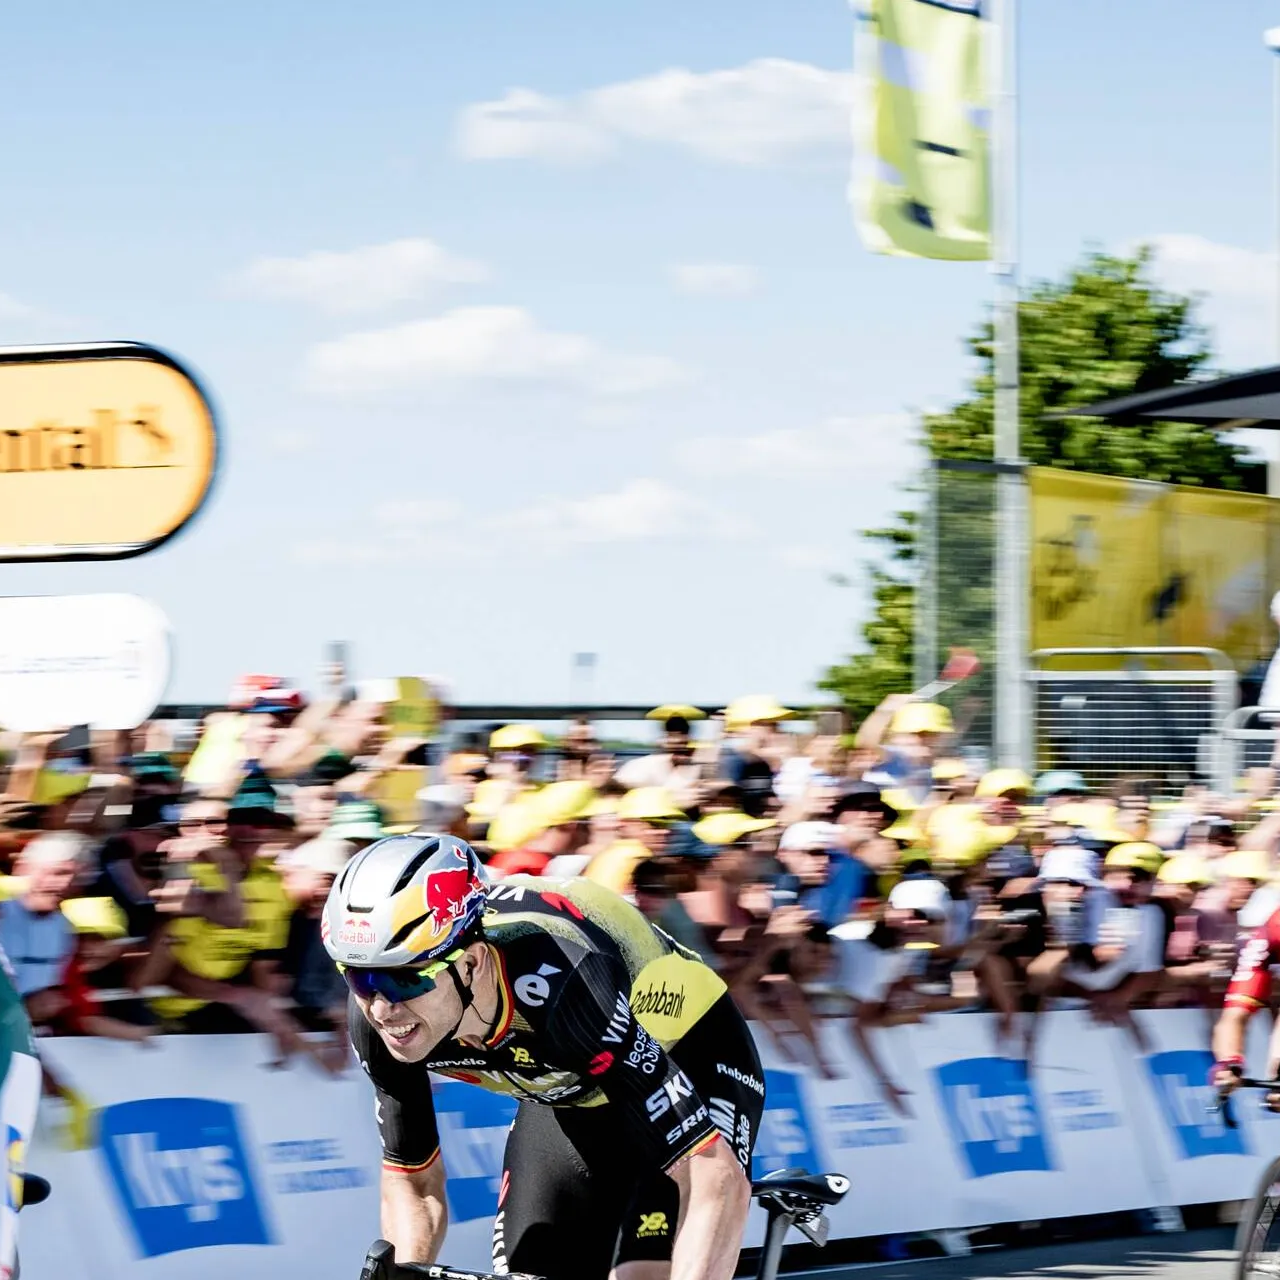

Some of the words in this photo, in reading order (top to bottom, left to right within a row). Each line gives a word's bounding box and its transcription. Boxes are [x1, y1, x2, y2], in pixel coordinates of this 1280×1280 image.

[338, 931, 355, 943] Red
[357, 932, 376, 943] Bull
[428, 939, 453, 959] GIRO
[426, 1058, 487, 1069] cervélo
[716, 1063, 765, 1097] Rabobank
